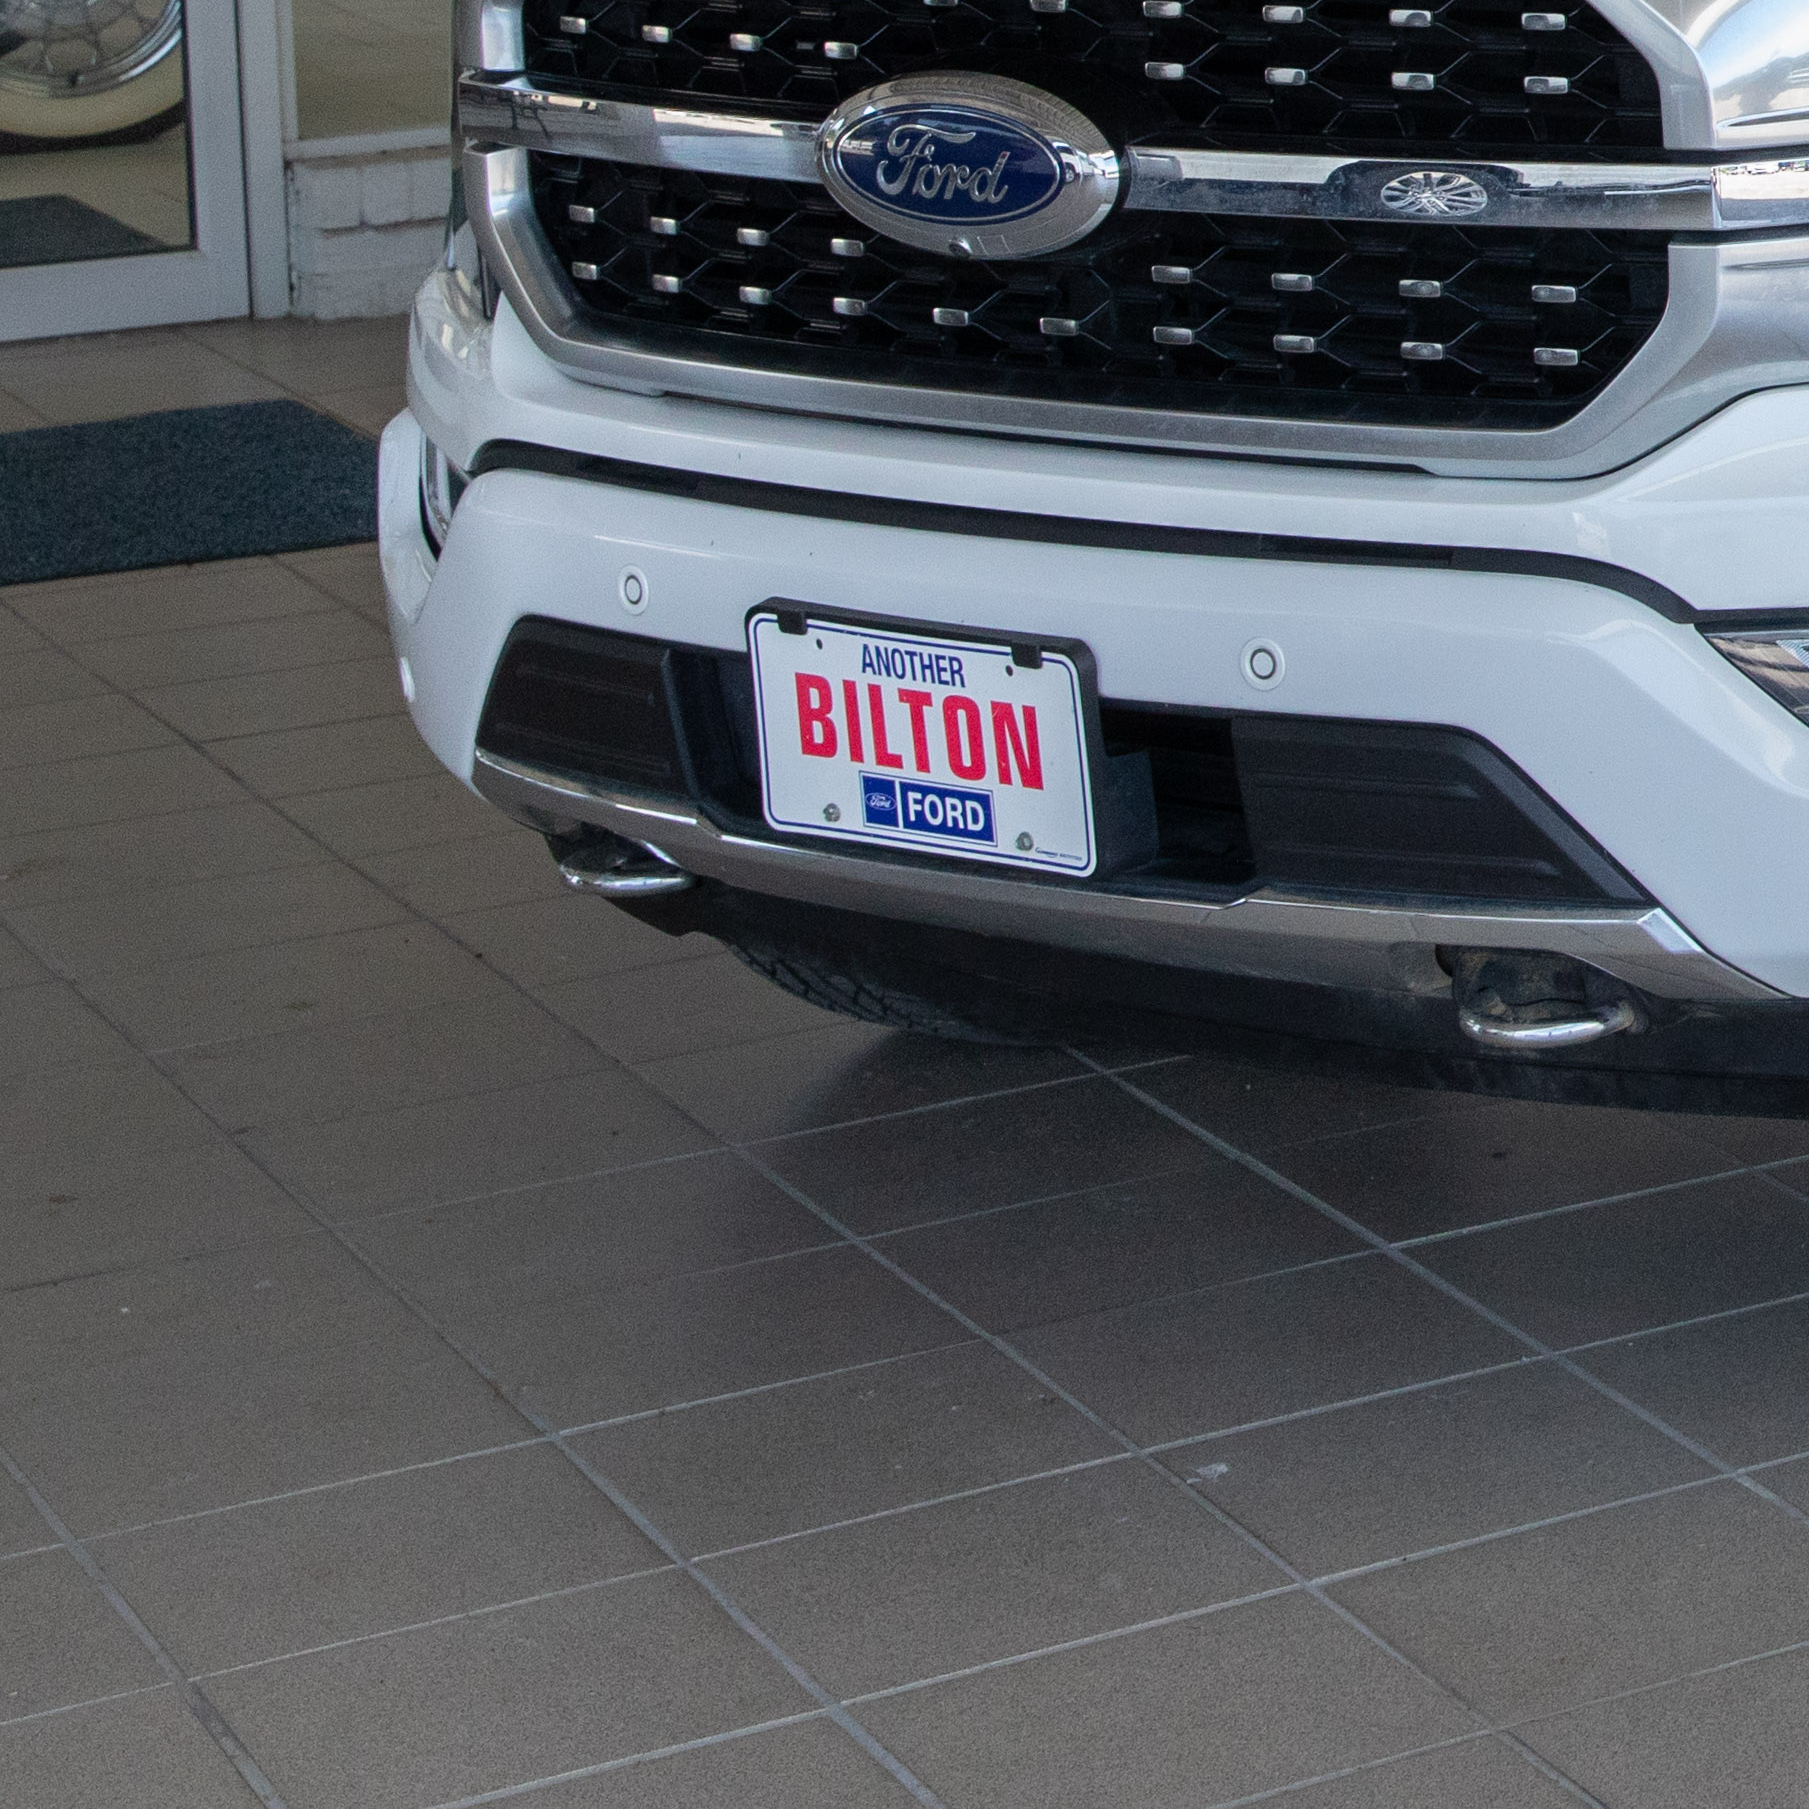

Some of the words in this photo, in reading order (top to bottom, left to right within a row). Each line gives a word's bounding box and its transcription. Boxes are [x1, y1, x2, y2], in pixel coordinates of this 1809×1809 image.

[876, 123, 1011, 205] Ford
[861, 643, 966, 689] ANOTHER
[794, 671, 1045, 791] BILTON
[906, 790, 986, 832] FORD
